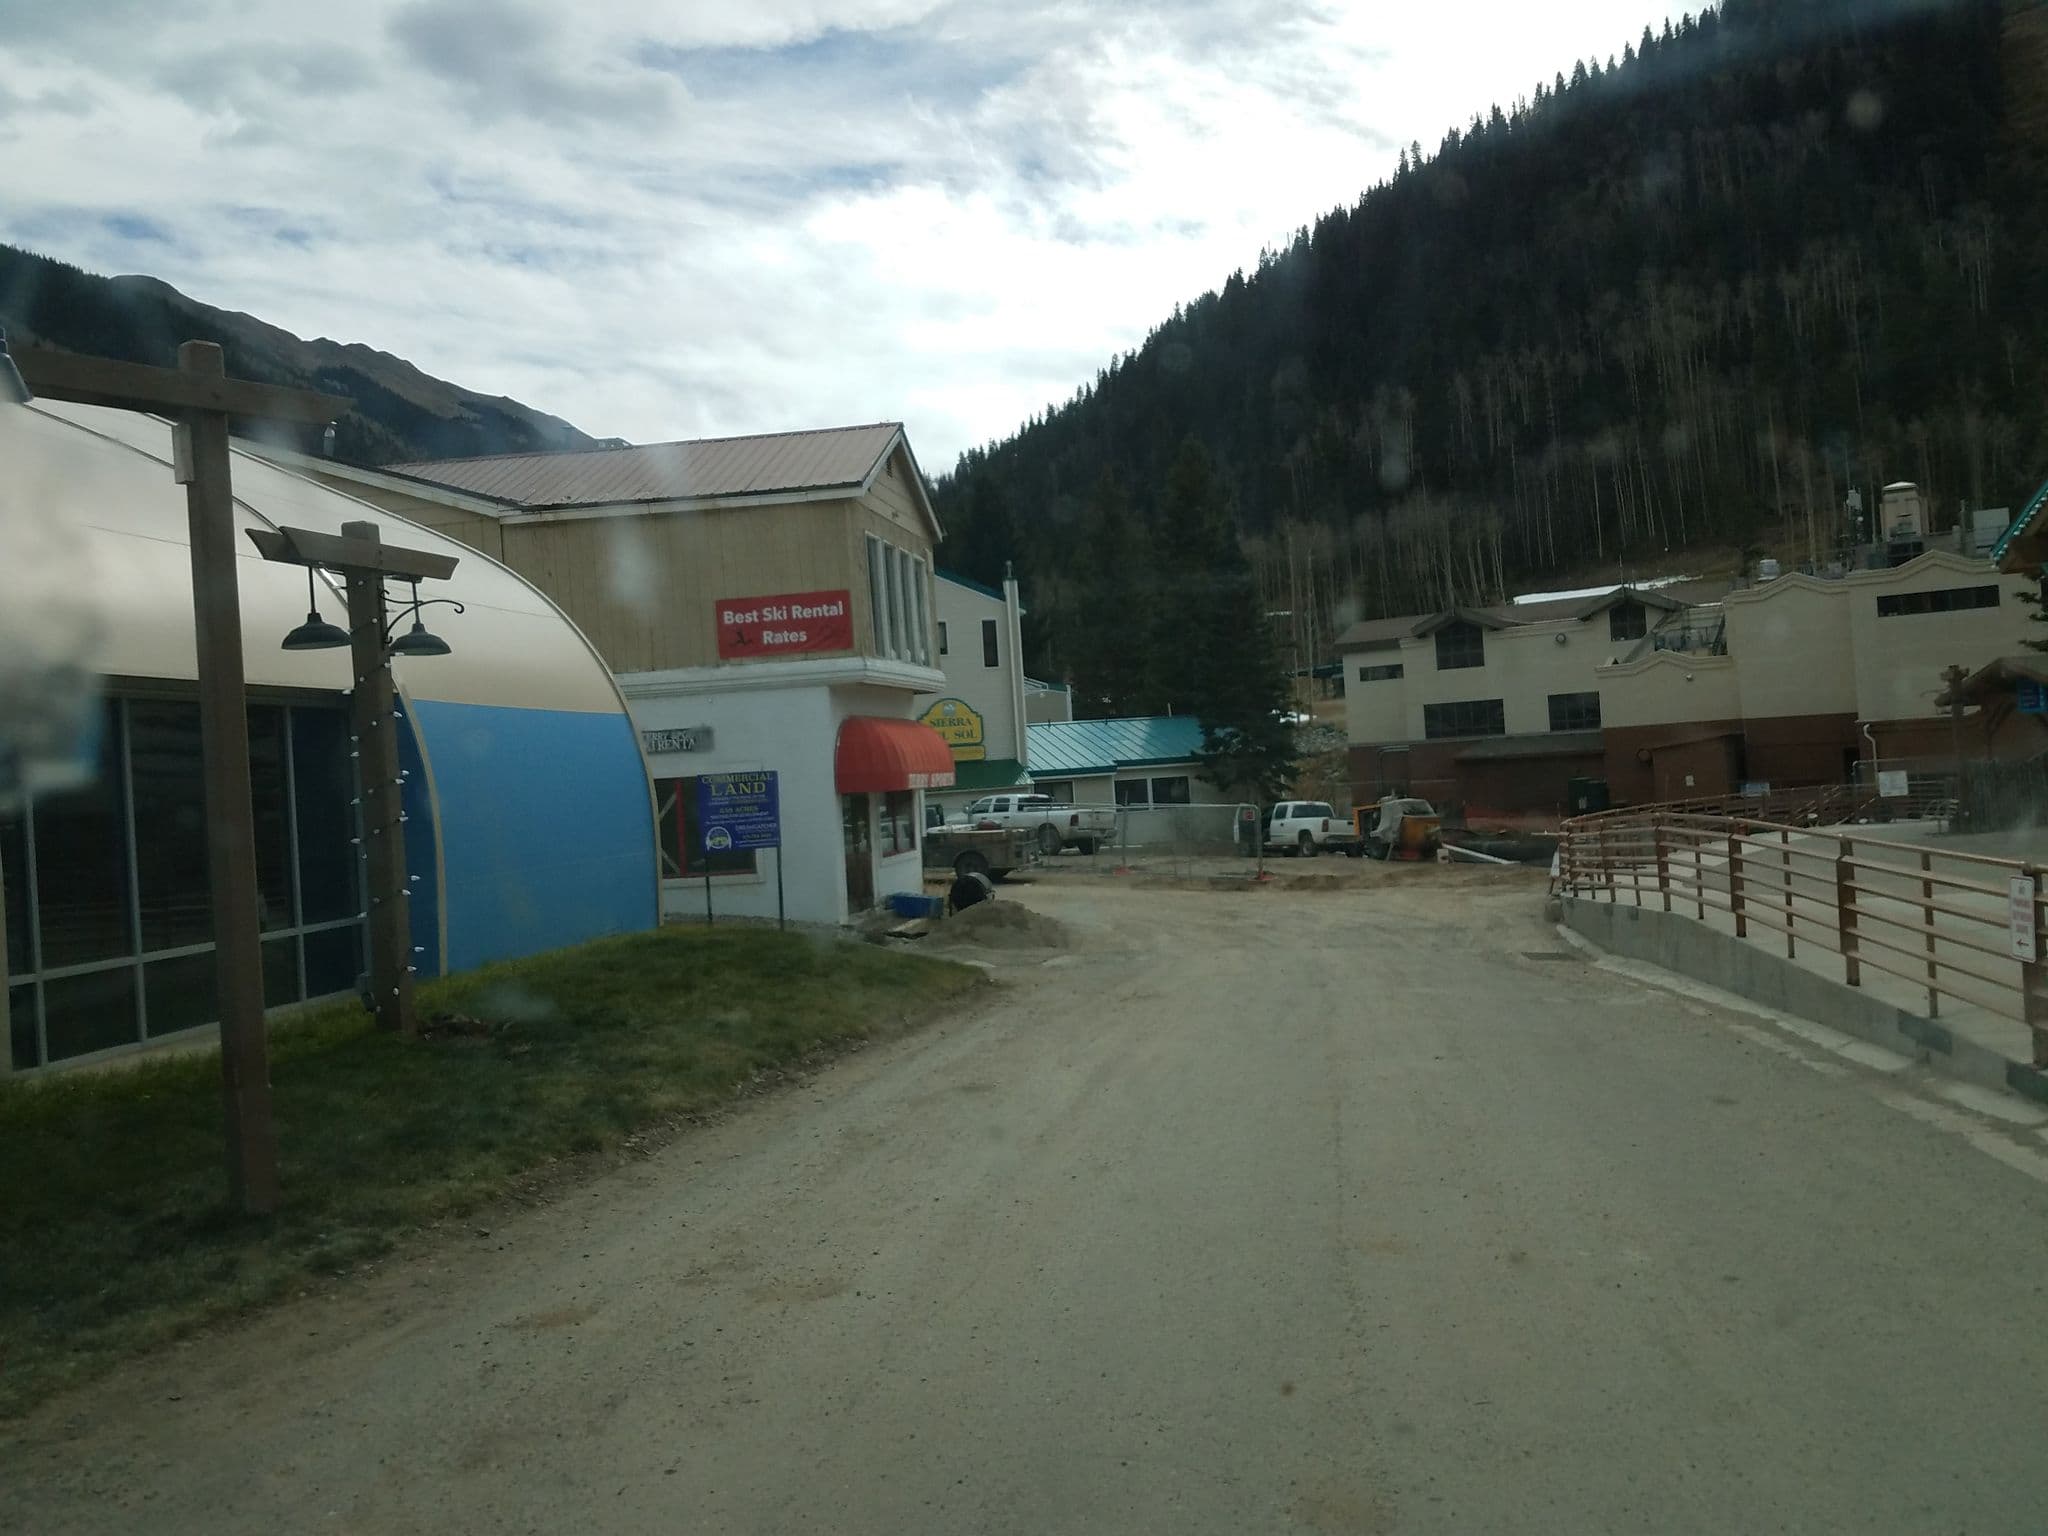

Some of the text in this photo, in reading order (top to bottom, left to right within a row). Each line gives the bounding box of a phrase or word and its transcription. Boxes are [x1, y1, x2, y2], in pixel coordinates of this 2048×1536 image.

[722, 600, 844, 625] Best Ski Rental
[762, 629, 808, 645] Rates
[929, 717, 973, 727] SIERRA
[953, 729, 977, 740] SOL
[701, 772, 773, 784] COMMERCIAL
[711, 782, 767, 796] LAND
